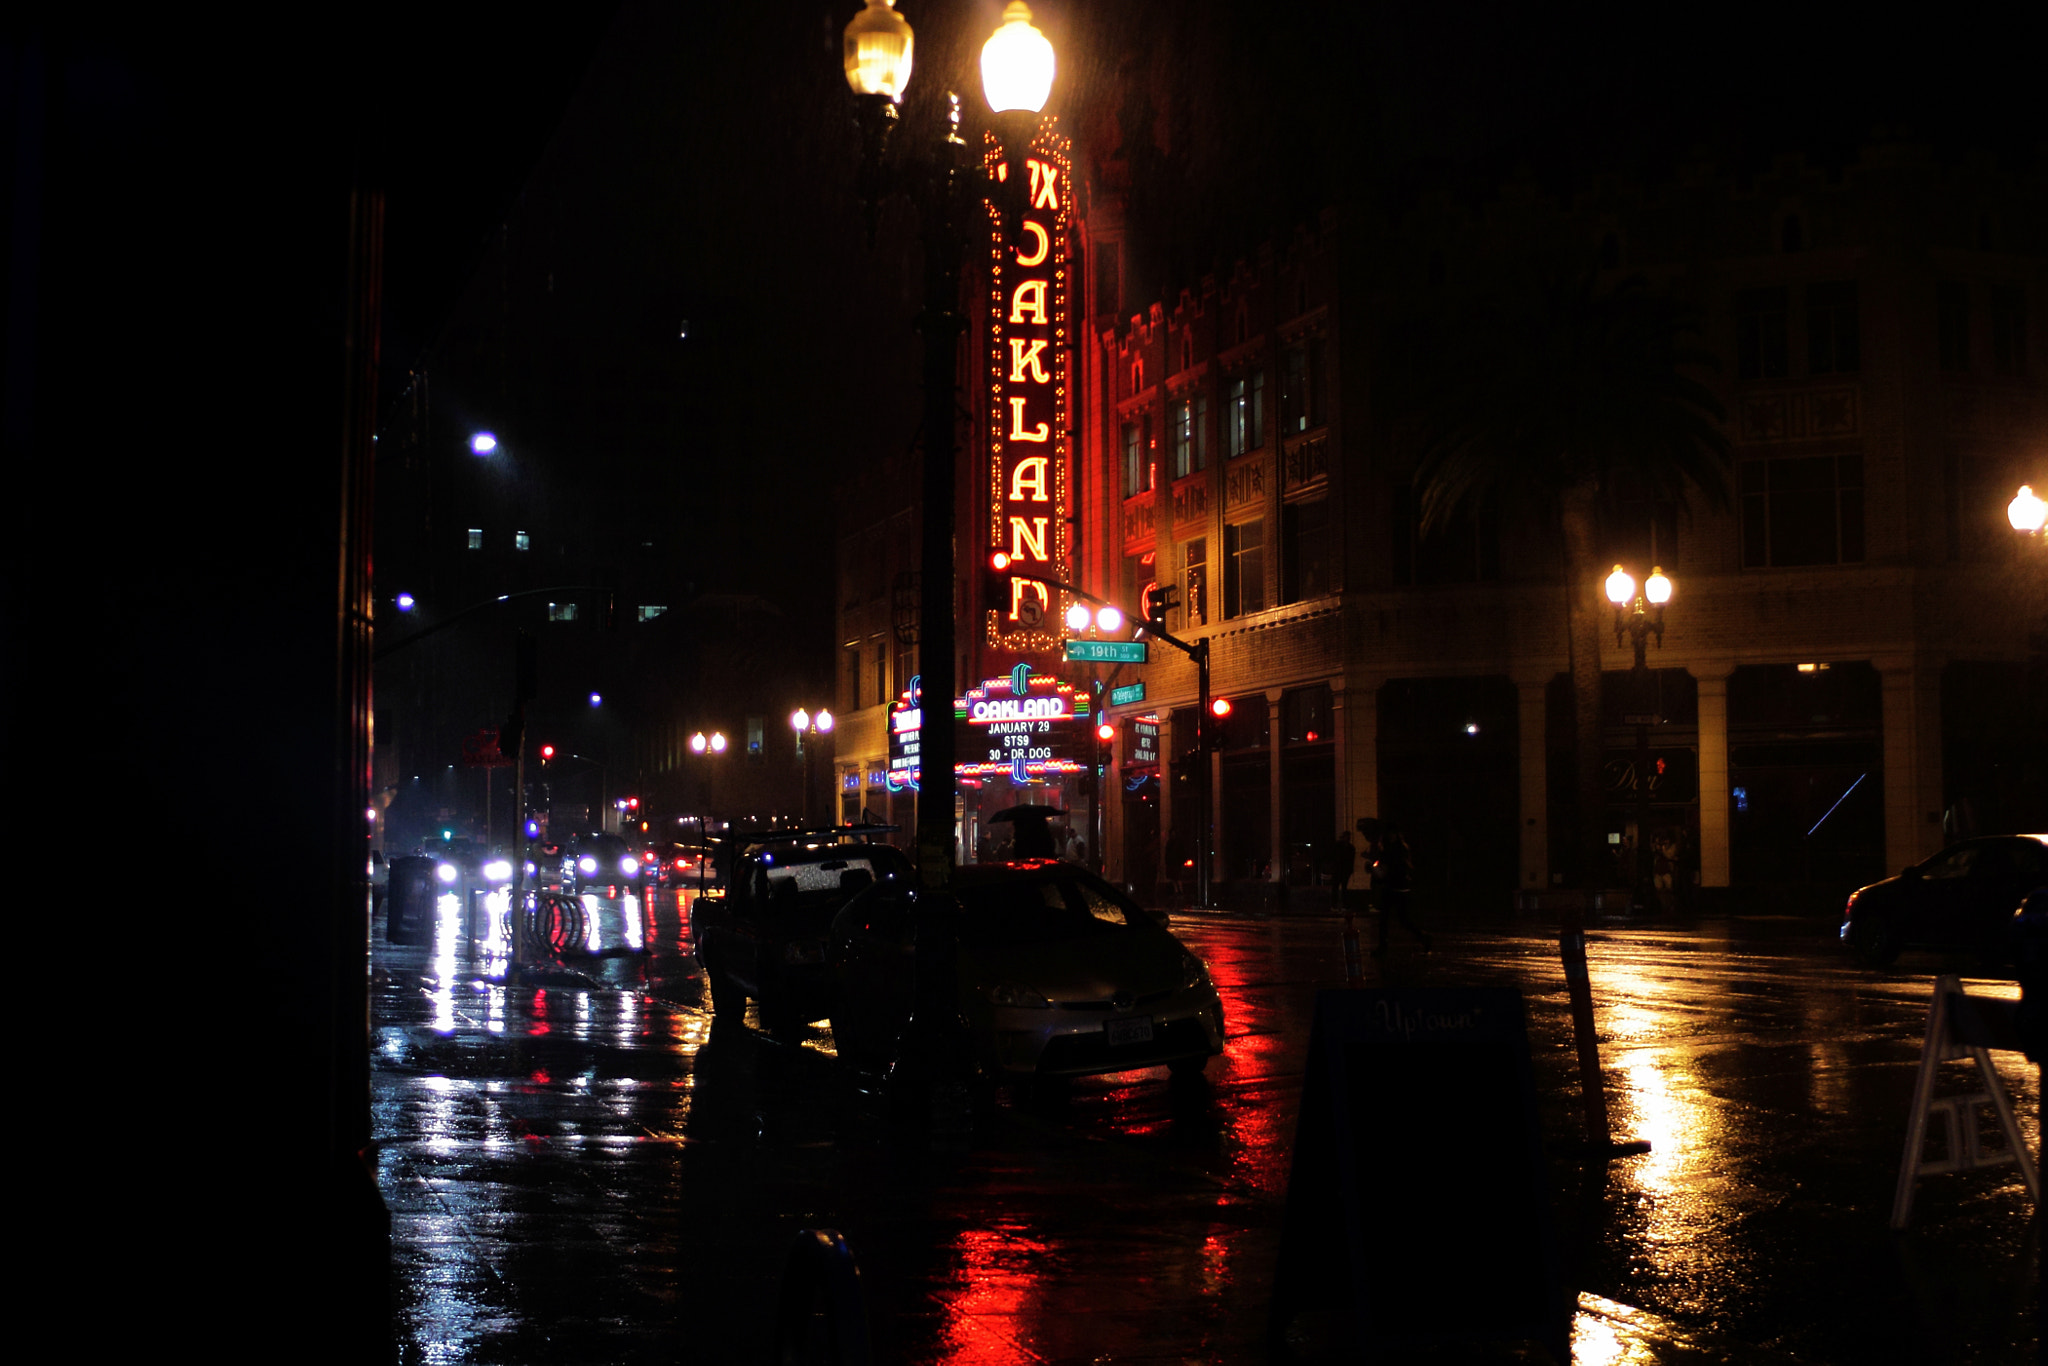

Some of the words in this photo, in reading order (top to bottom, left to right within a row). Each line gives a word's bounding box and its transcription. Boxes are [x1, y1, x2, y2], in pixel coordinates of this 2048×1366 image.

[1009, 220, 1050, 621] OAKLAND
[1090, 645, 1117, 658] 19th
[973, 697, 1063, 719] OAKLAND
[988, 721, 1034, 734] JANUARY
[1038, 720, 1050, 732] 29
[1004, 734, 1030, 747] STS9
[989, 748, 1001, 760] 30
[1011, 748, 1027, 760] DR.
[1029, 747, 1051, 759] DOG
[1373, 998, 1476, 1045] Uptown
